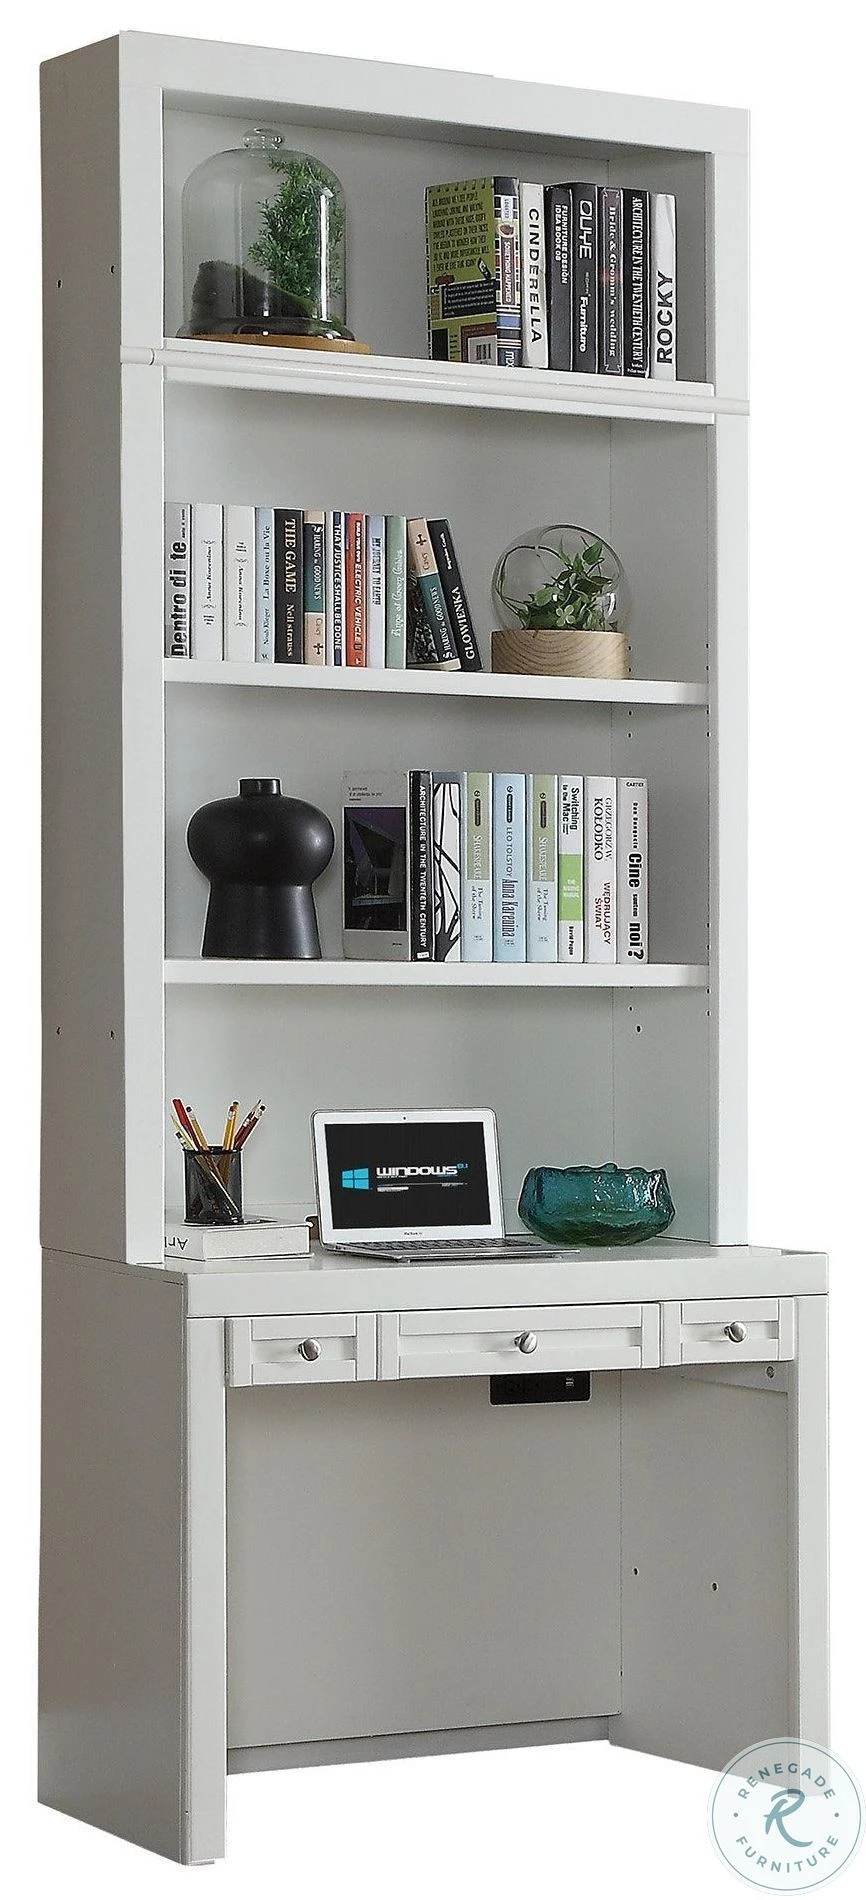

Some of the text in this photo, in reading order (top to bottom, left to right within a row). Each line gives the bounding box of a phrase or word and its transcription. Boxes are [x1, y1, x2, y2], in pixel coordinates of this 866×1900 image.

[609, 207, 617, 238] Bride
[609, 240, 617, 251] &
[529, 208, 543, 343] CINDERELLA
[632, 266, 643, 281] THE
[579, 296, 589, 353] Furniture
[608, 309, 617, 357] wedding
[656, 270, 673, 364] ROCKY
[632, 326, 643, 362] CENTURY
[284, 518, 296, 593] THE GAME
[313, 565, 322, 582] GOOD
[169, 541, 187, 656] Dentro di te
[313, 582, 322, 599] NEWS
[334, 524, 342, 650] THAT JUSTICE SHALL BE DONE
[354, 563, 362, 604] ELECTRIC
[286, 604, 294, 623] Neil
[354, 606, 362, 642] VEHICLE
[451, 585, 475, 660] GLOWIENKA
[562, 803, 571, 822] Mac
[570, 787, 580, 830] Switching
[419, 854, 427, 869] THE
[628, 853, 642, 888] Cine
[502, 879, 519, 898] Anna
[419, 913, 427, 947] CENTURY
[502, 901, 519, 937] Karenina
